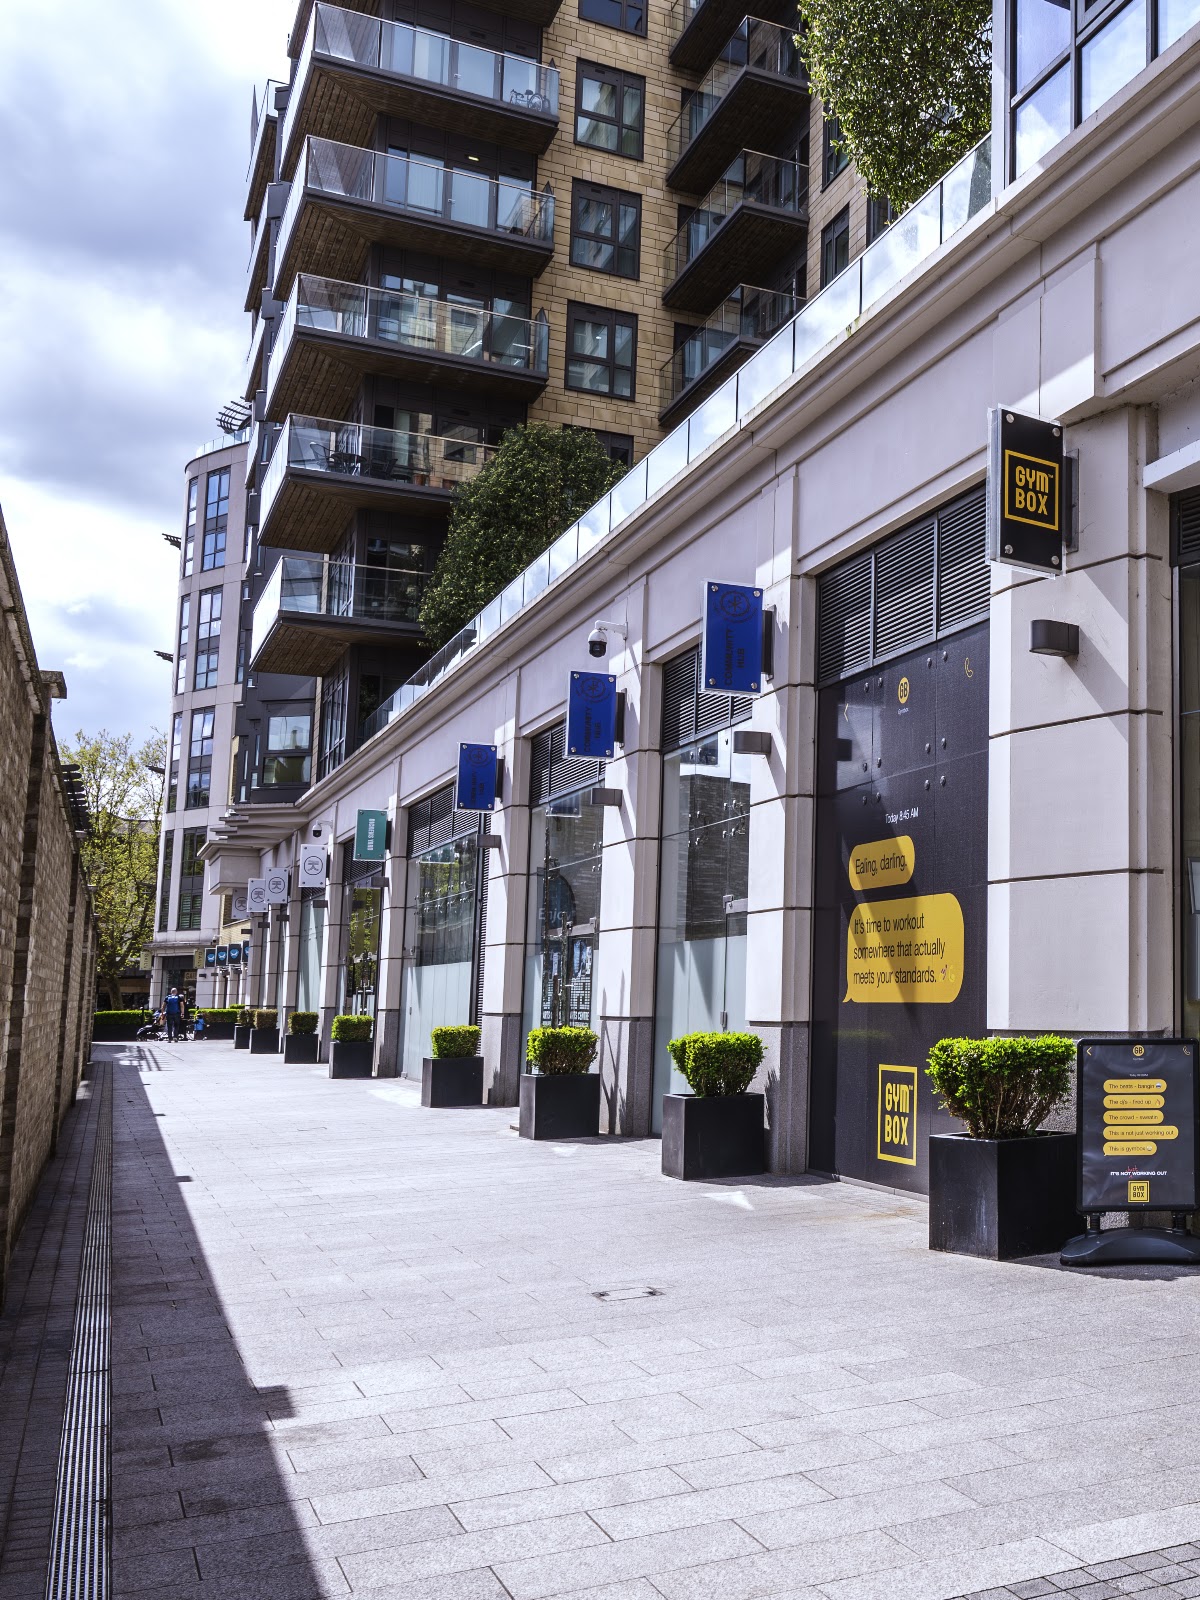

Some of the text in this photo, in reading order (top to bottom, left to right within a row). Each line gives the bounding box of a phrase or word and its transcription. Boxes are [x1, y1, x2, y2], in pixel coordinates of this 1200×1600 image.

[1015, 487, 1048, 516] BOX
[724, 628, 734, 686] COMMUNITY
[737, 648, 745, 669] HUB
[885, 812, 898, 824] Today
[910, 806, 919, 818] AM
[855, 853, 907, 877] Ealing, darling.
[854, 913, 925, 935] It's time to workout
[853, 937, 945, 960] somewhere that actually
[853, 966, 937, 988] meets your standards.
[885, 1082, 910, 1113] GYM
[884, 1114, 909, 1146] BOX
